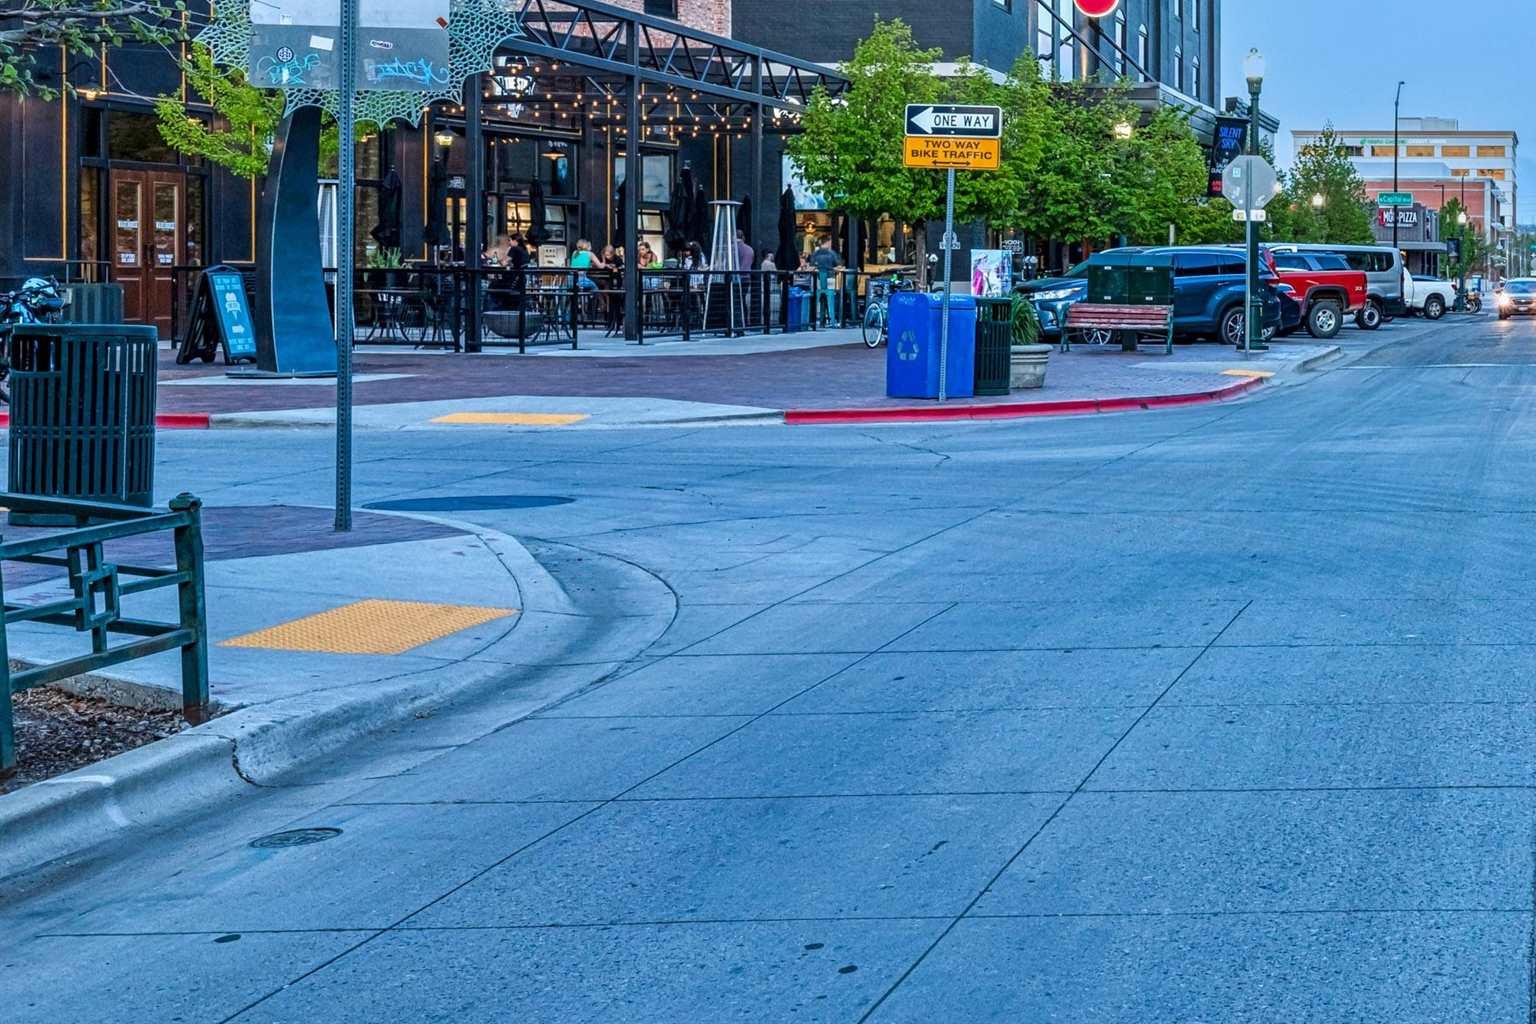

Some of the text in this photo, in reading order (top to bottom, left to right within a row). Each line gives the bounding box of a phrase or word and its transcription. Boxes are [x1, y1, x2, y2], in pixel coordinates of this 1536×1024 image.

[933, 114, 990, 127] ONE WAY
[1219, 126, 1243, 138] SILENT
[924, 140, 980, 149] TWO WAY
[1221, 139, 1237, 150] SKY
[911, 149, 992, 160] BIKE TRAFFIC
[1398, 211, 1418, 223] PIZZA
